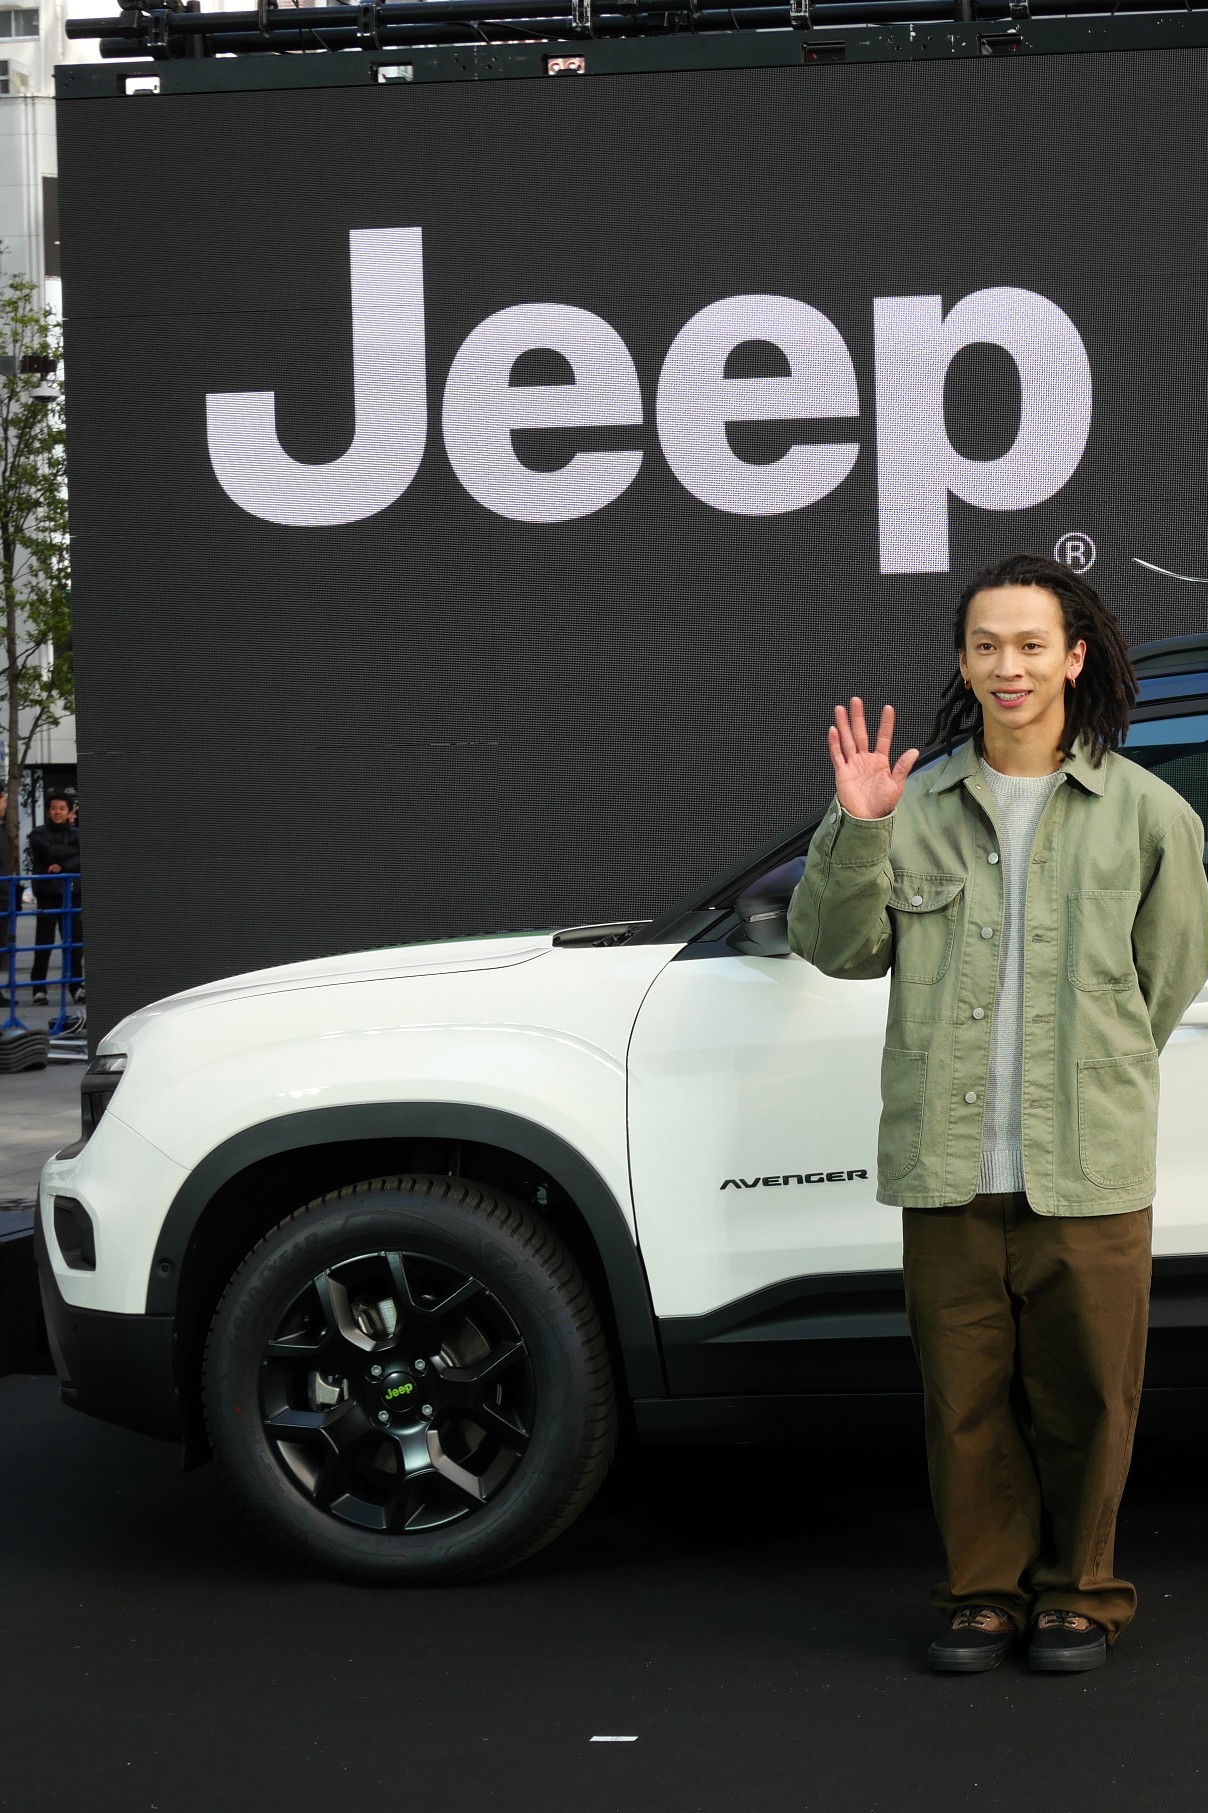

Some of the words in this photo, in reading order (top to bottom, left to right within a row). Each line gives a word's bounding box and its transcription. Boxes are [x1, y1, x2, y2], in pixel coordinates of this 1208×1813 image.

[205, 227, 1093, 574] Jeep
[720, 1169, 869, 1190] AVENGER
[385, 1383, 413, 1400] Jeep
